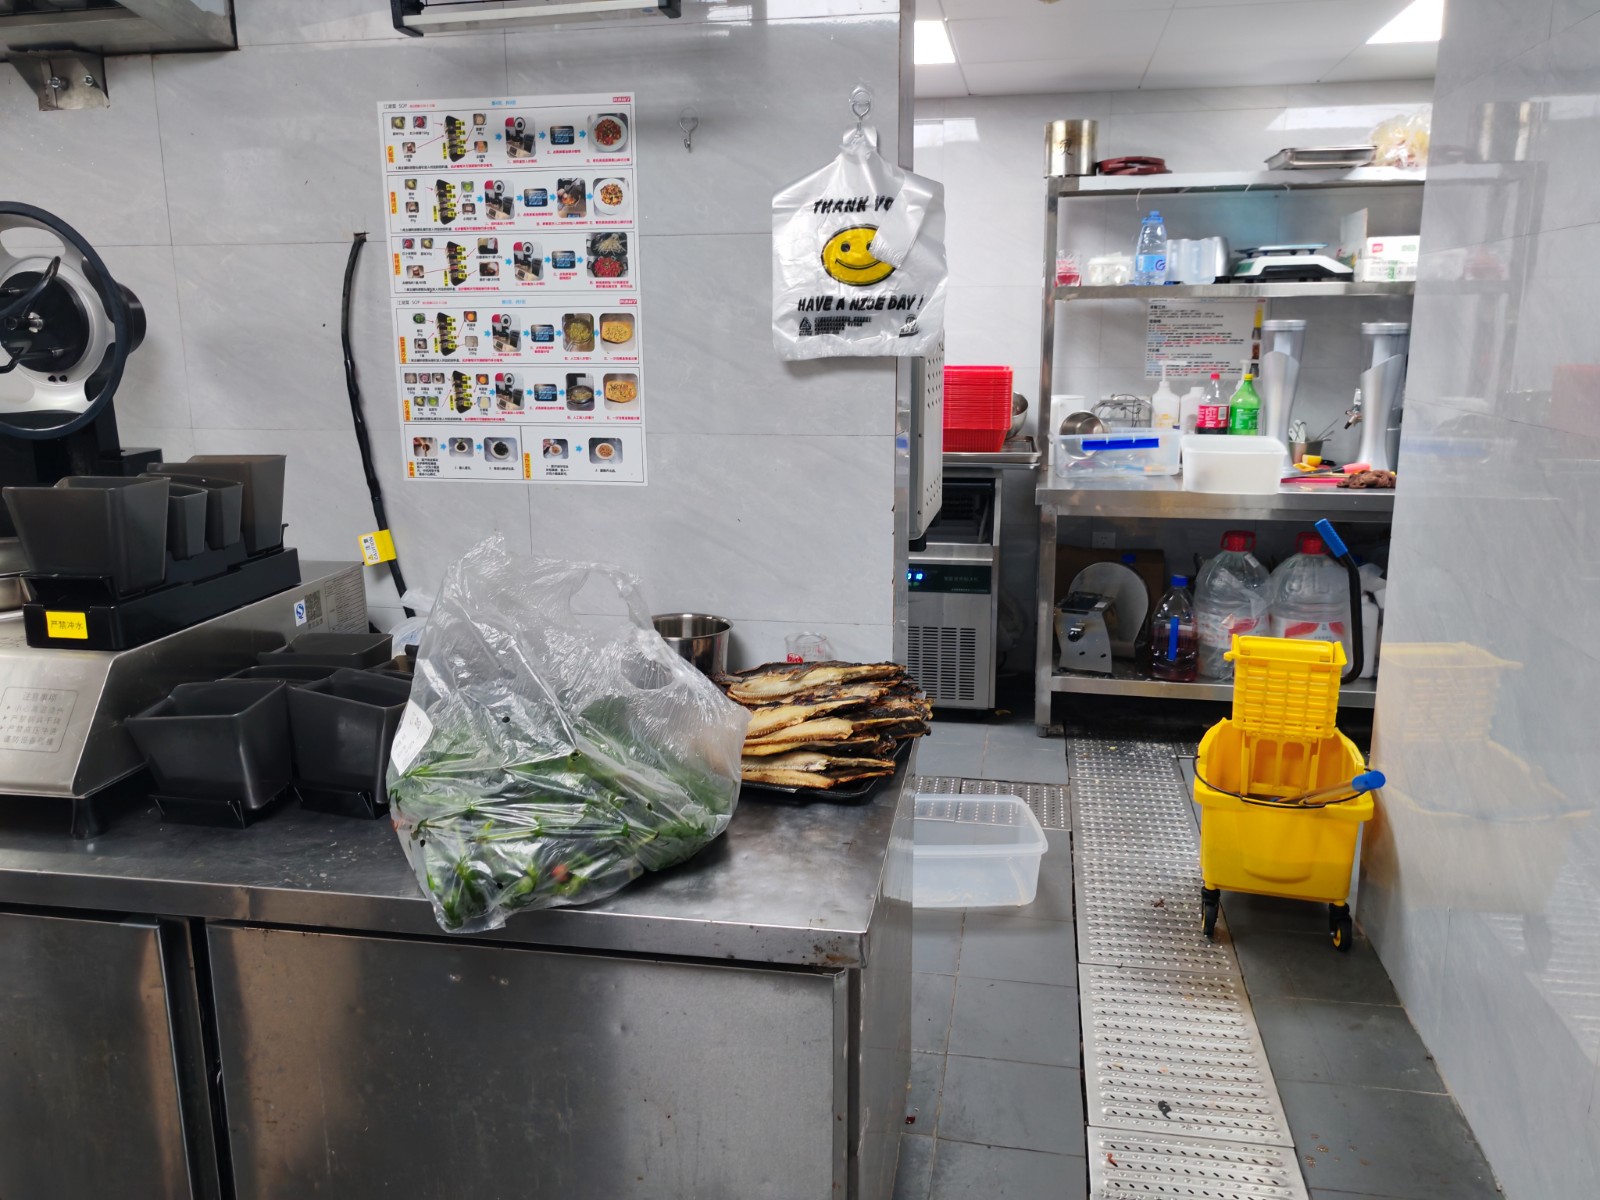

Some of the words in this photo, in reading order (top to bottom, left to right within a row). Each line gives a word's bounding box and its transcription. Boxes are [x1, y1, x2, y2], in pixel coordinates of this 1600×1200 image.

[813, 196, 869, 214] THANK
[874, 195, 894, 212] YO
[798, 295, 833, 311] HAVE
[835, 297, 845, 311] A
[887, 294, 917, 310] DAY
[51, 620, 84, 630] 严禁冲水
[23, 692, 58, 702] 注意事项
